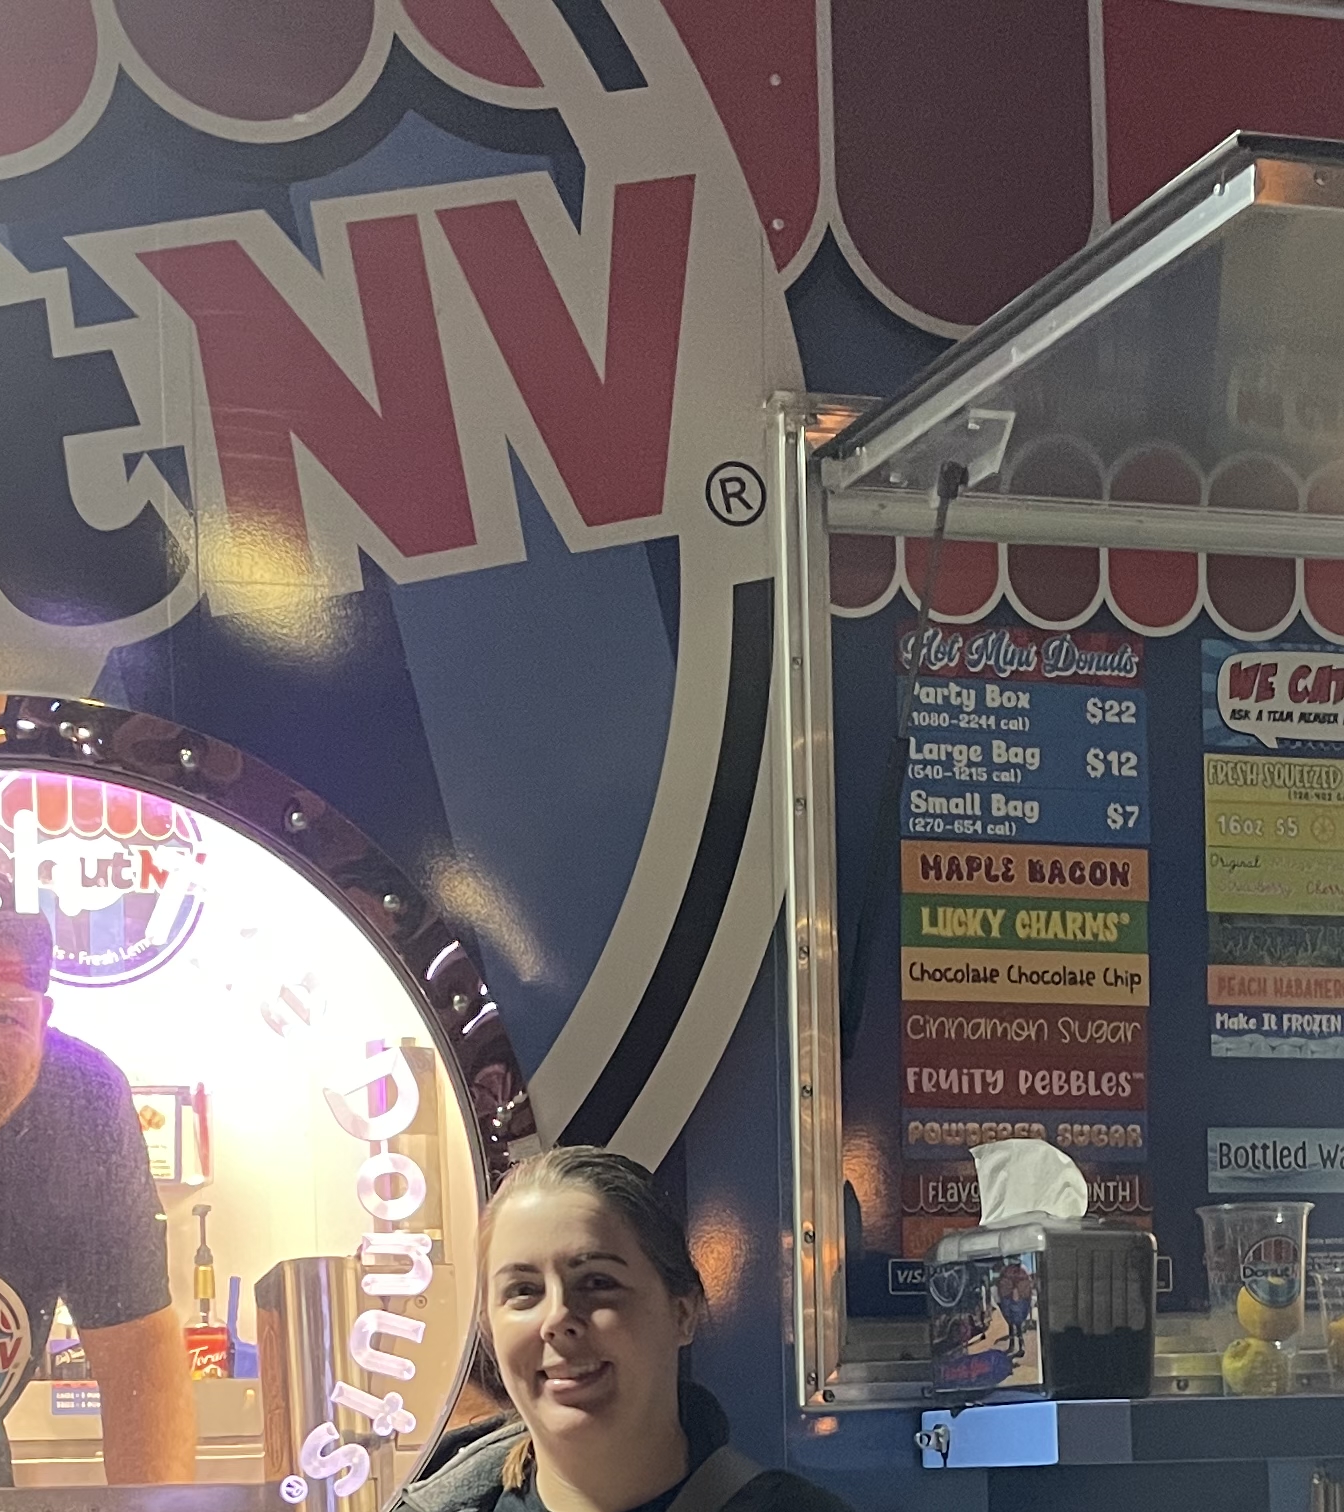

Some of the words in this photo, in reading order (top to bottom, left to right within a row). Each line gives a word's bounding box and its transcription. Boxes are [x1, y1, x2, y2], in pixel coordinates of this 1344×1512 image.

[900, 628, 962, 670] Hot
[965, 629, 1038, 677] Mini
[1041, 633, 1140, 678] Donuts
[1228, 660, 1279, 703] WE
[913, 681, 977, 712] arty
[985, 683, 1031, 709] Box
[1085, 696, 1137, 725] $22
[1229, 708, 1252, 722] ASK
[1256, 709, 1263, 722] A
[1267, 709, 1294, 724] TEAM
[909, 711, 996, 730] 1080-2244
[1000, 716, 1031, 731] cal)
[909, 736, 983, 767] Large
[992, 740, 1041, 770] Bag
[1086, 747, 1138, 779] $12
[992, 768, 1022, 783] cal)
[1208, 760, 1258, 787] FRESH
[1262, 762, 1343, 791] SQUEEZED
[910, 789, 982, 816] Small
[991, 794, 1040, 823] Bag
[1106, 802, 1140, 830] $7
[987, 821, 1017, 836] cal)
[920, 853, 1015, 884] MAPLE
[1027, 858, 1131, 888] BACON
[920, 906, 1006, 938] LUCKY
[909, 961, 1000, 984] Chocolate
[1007, 964, 1097, 987] Chocolate
[1102, 967, 1143, 994] Chip
[1217, 975, 1267, 997] PEACH
[907, 1014, 1049, 1042] Cinnamon
[1215, 1012, 1257, 1031] Make
[1262, 1012, 1279, 1031] It
[1282, 1013, 1343, 1038] FROZEN
[1056, 1122, 1144, 1148] SUGAR
[1218, 1140, 1307, 1171] Bottled
[1088, 1180, 1131, 1202] NTH
